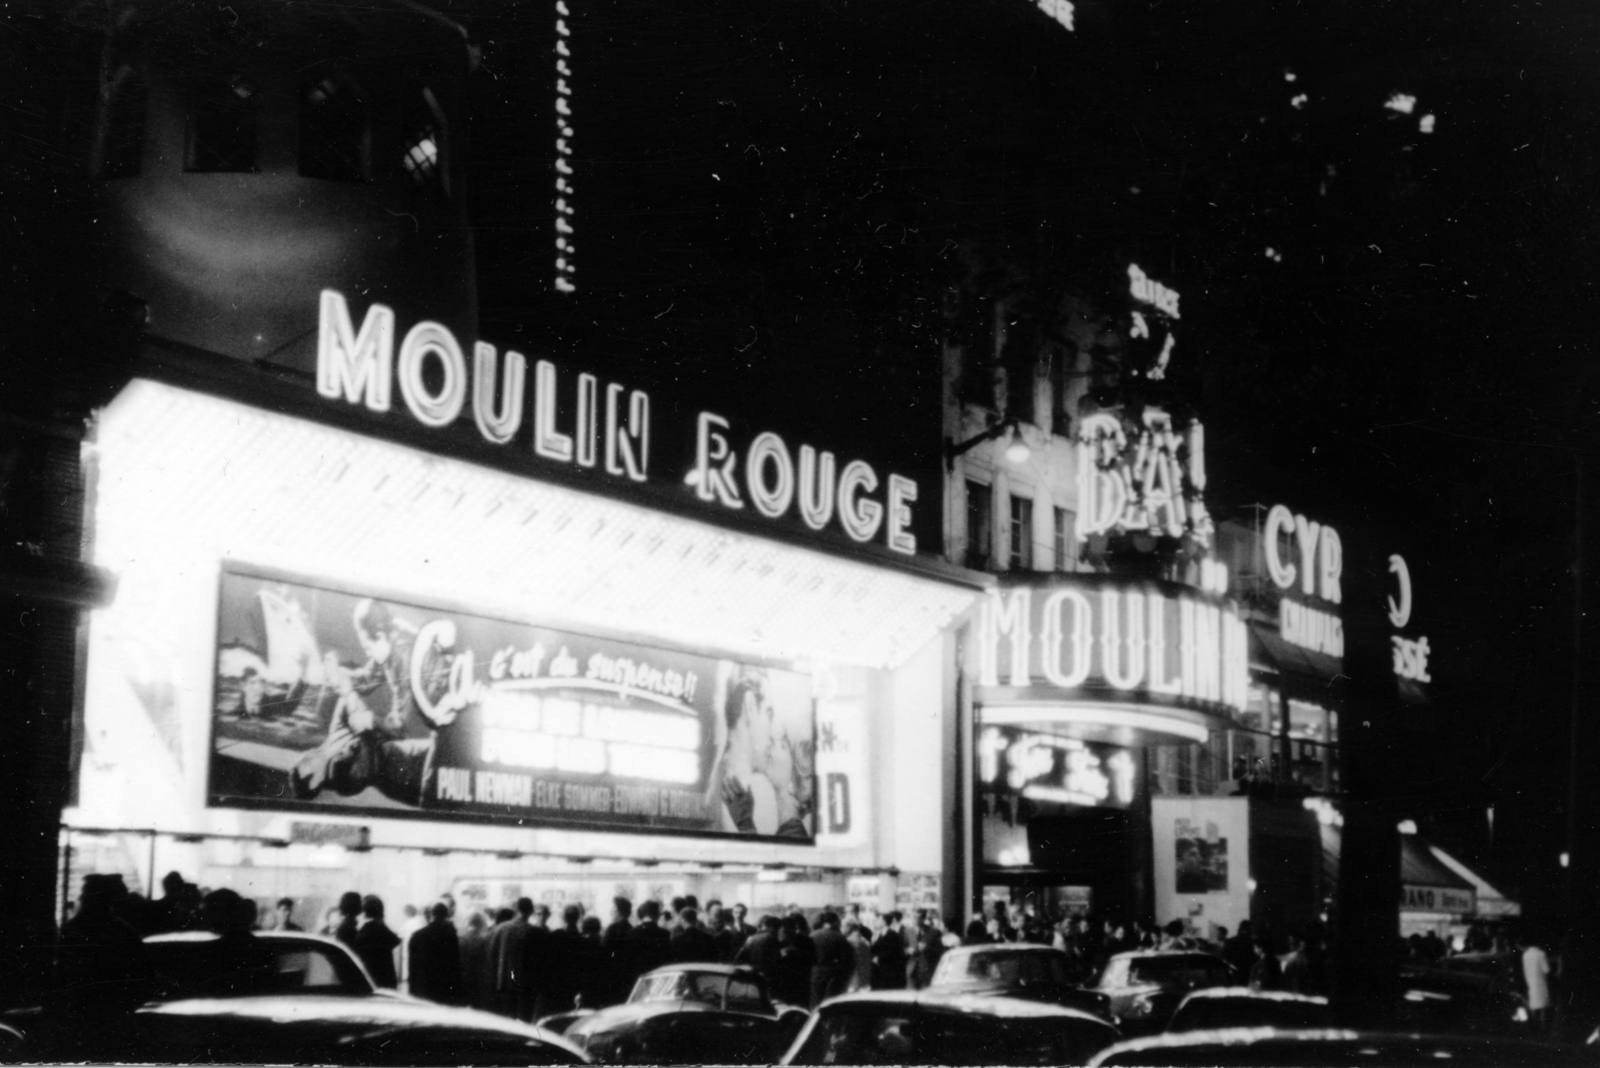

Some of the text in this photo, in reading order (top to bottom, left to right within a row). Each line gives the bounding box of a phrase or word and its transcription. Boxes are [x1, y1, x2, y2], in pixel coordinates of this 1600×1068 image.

[316, 288, 918, 555] MOULIN ROUGE
[978, 585, 1249, 714] MOULIN
[437, 767, 472, 800] PAUL
